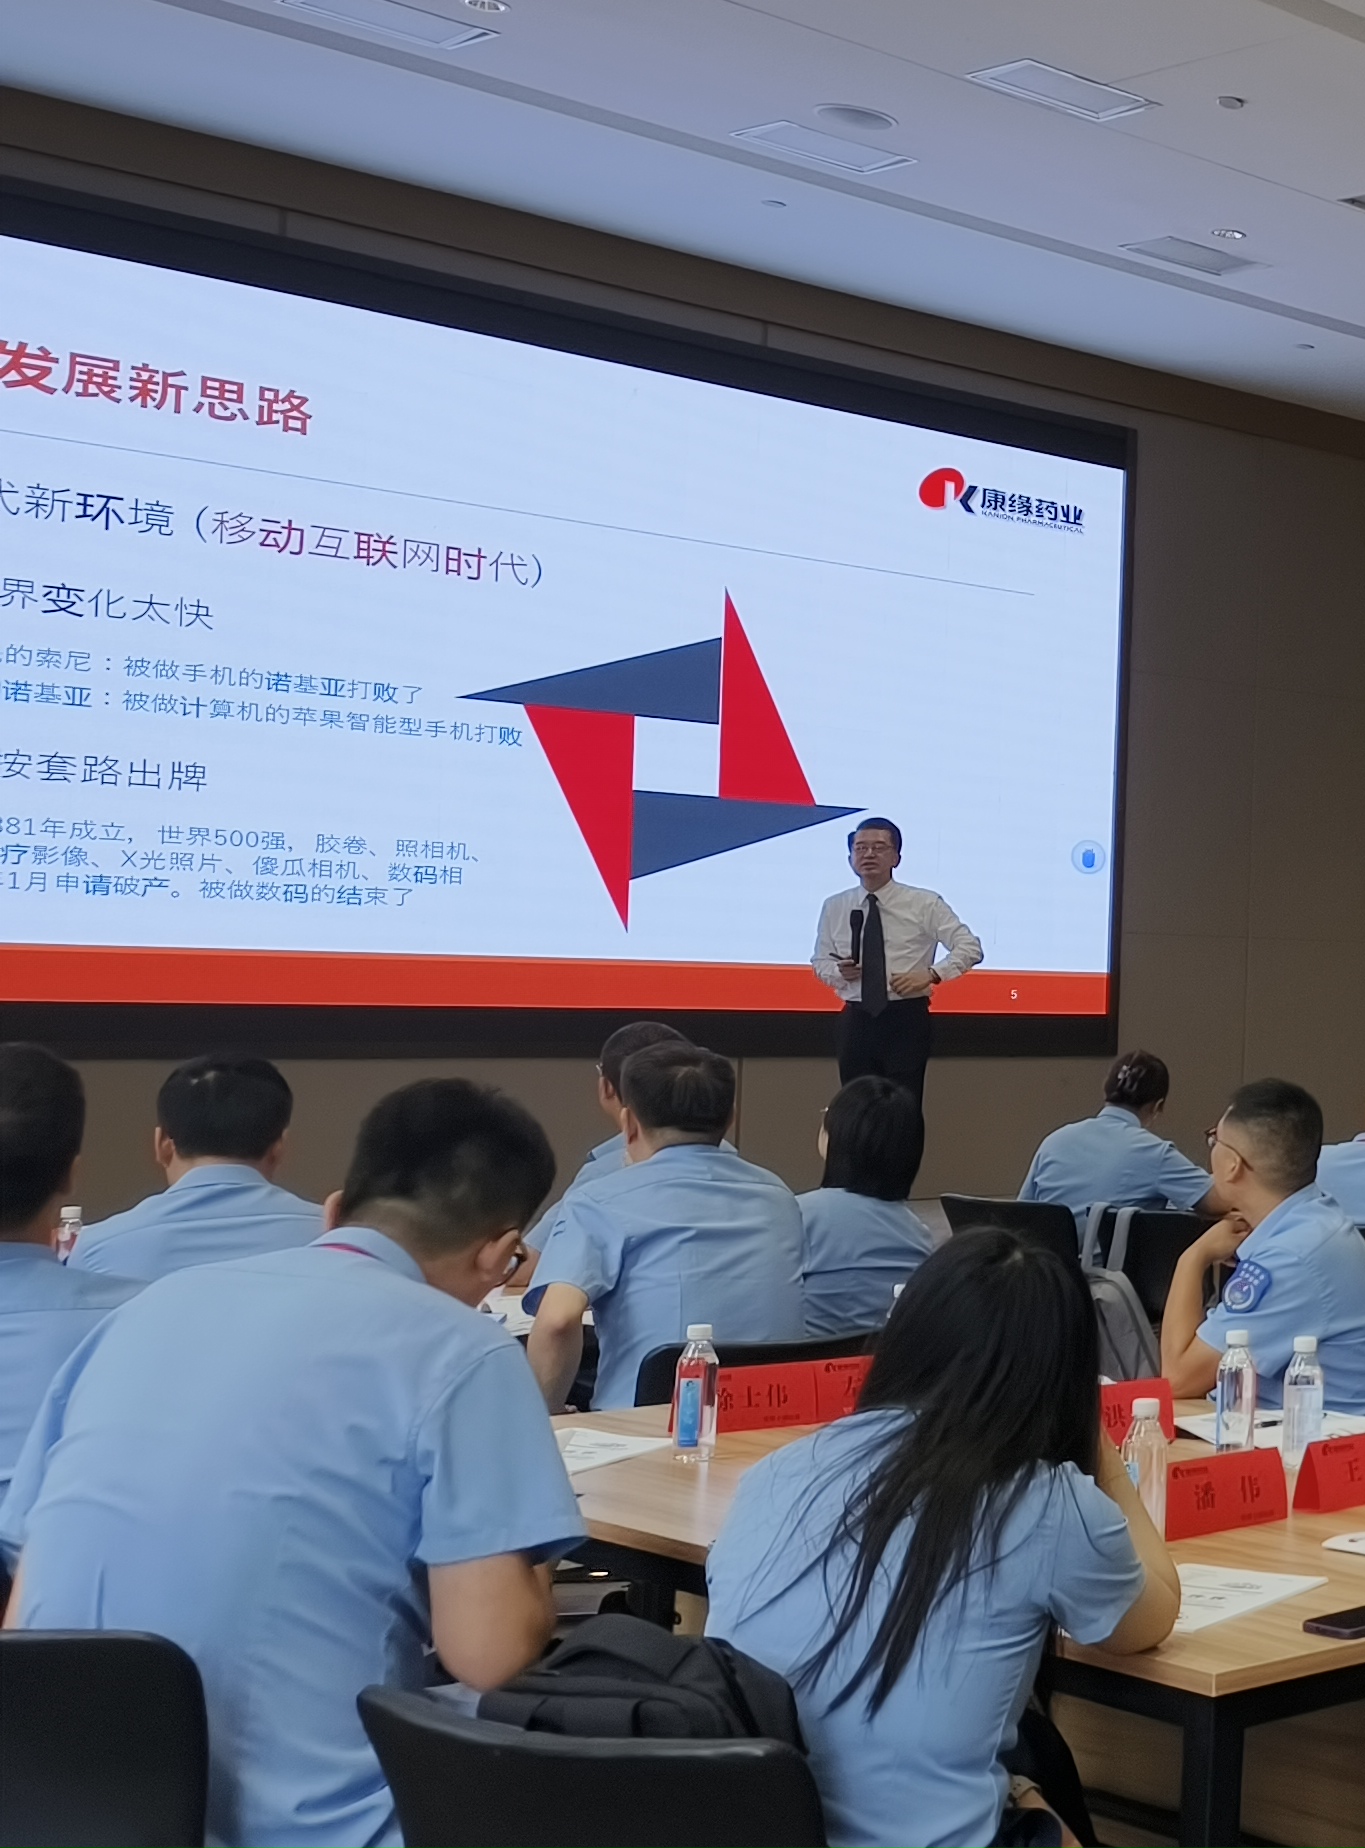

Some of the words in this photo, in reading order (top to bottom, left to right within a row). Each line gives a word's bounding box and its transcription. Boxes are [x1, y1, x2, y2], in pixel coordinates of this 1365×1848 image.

[0, 339, 313, 436] 发展新思路
[981, 487, 1084, 527] 康缘药业
[981, 510, 1014, 523] KANION
[1016, 516, 1084, 534] PHARMACEUTICAL
[0, 577, 214, 631] 界变化太快
[0, 644, 424, 705] 的索尼：被做手机的诺基亚打败了
[0, 680, 524, 748] 诺基亚：被做计算机的苹果智能型手机打败
[0, 815, 480, 864] 81年成立，世界500强，胶卷、照相机、
[0, 871, 413, 908] 1月申请破产。被做数码的结束了
[1010, 989, 1018, 1000] 5
